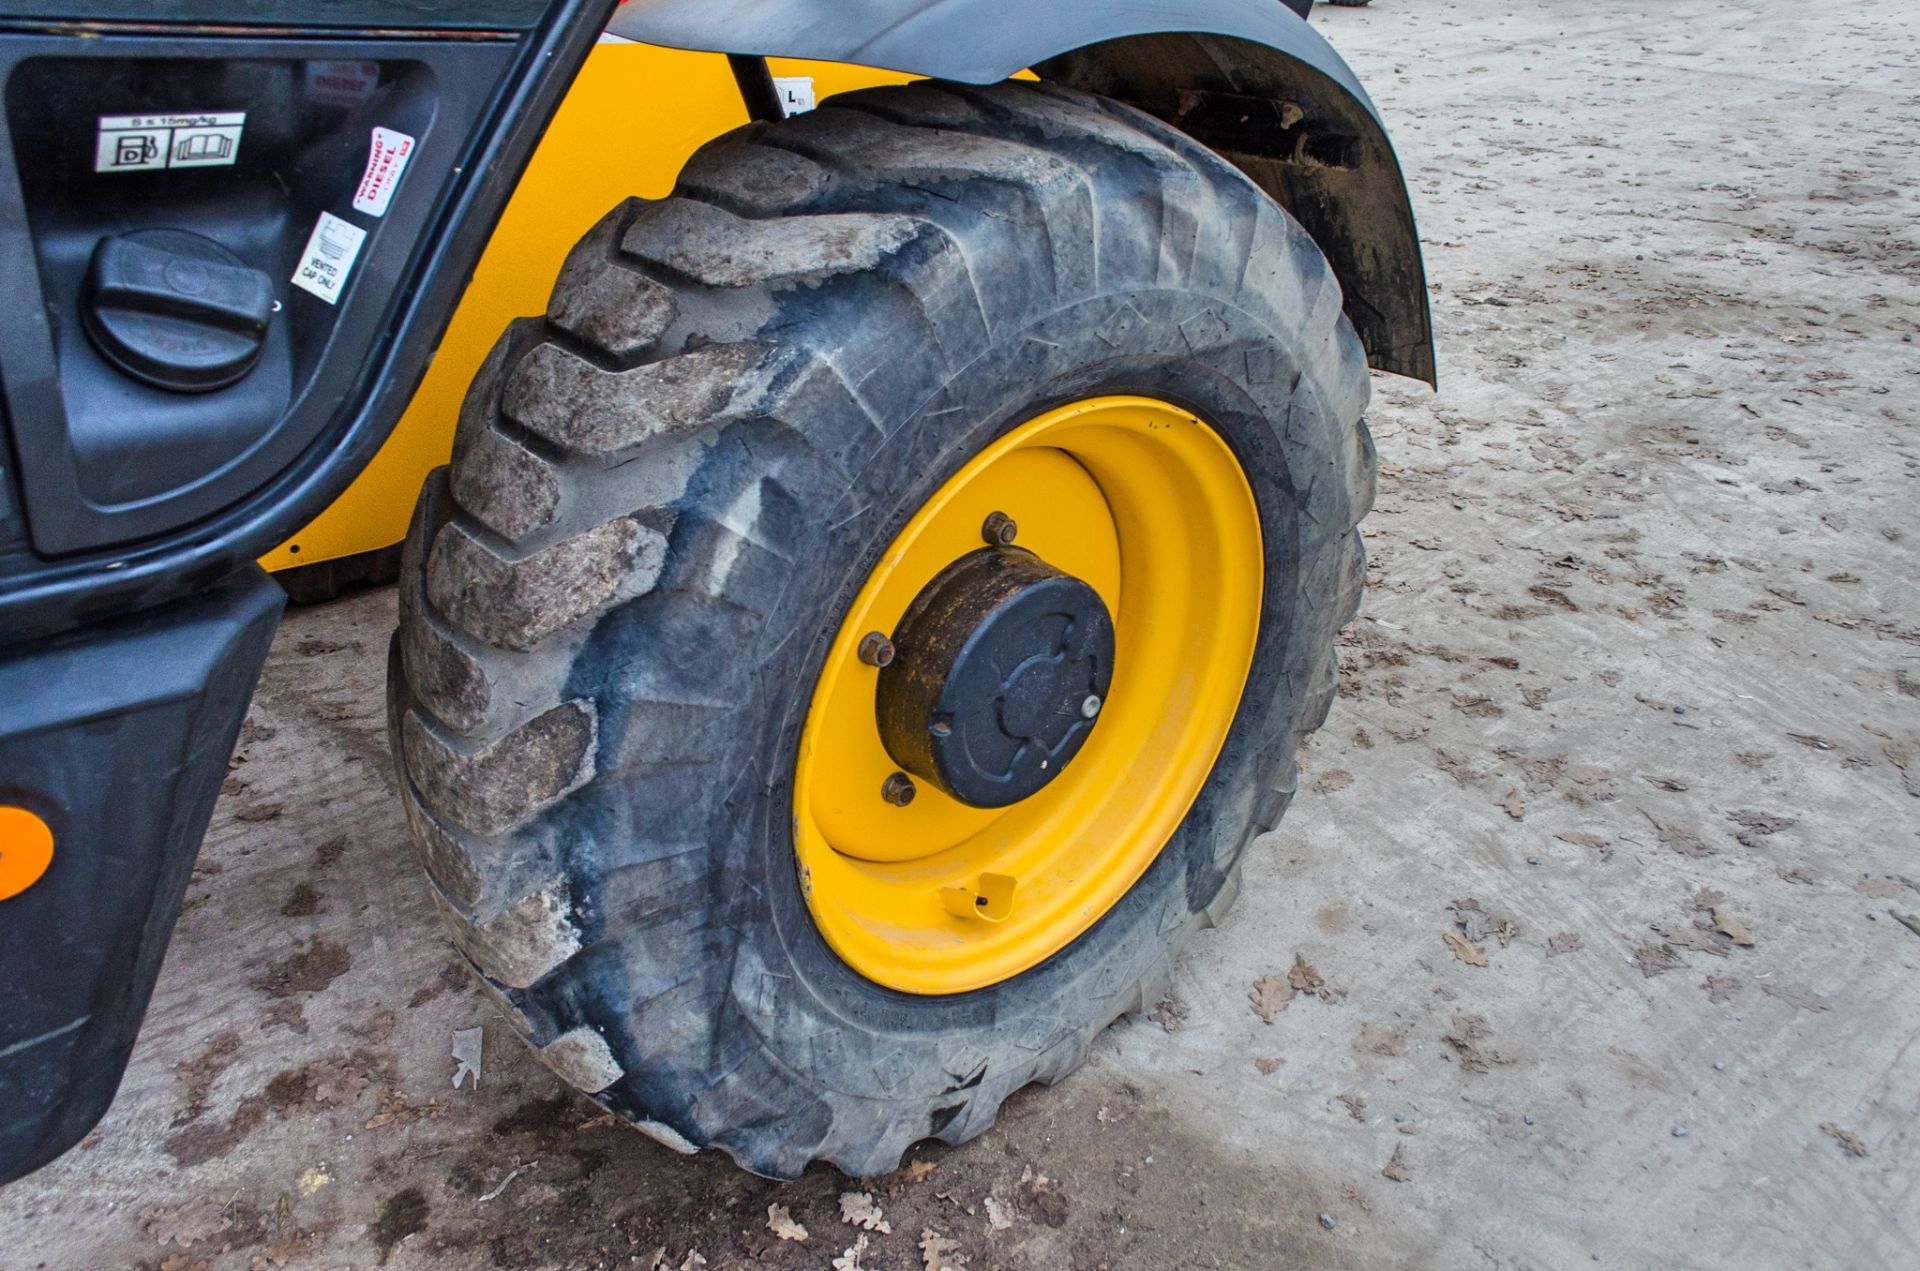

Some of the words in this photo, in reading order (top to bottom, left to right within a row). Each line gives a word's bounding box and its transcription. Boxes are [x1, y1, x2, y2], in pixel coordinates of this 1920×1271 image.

[788, 90, 796, 103] L
[125, 149, 138, 161] D
[367, 146, 397, 201] DIESEL
[311, 257, 338, 278] VENTED
[302, 266, 317, 280] CAP
[317, 275, 336, 291] ONLY
